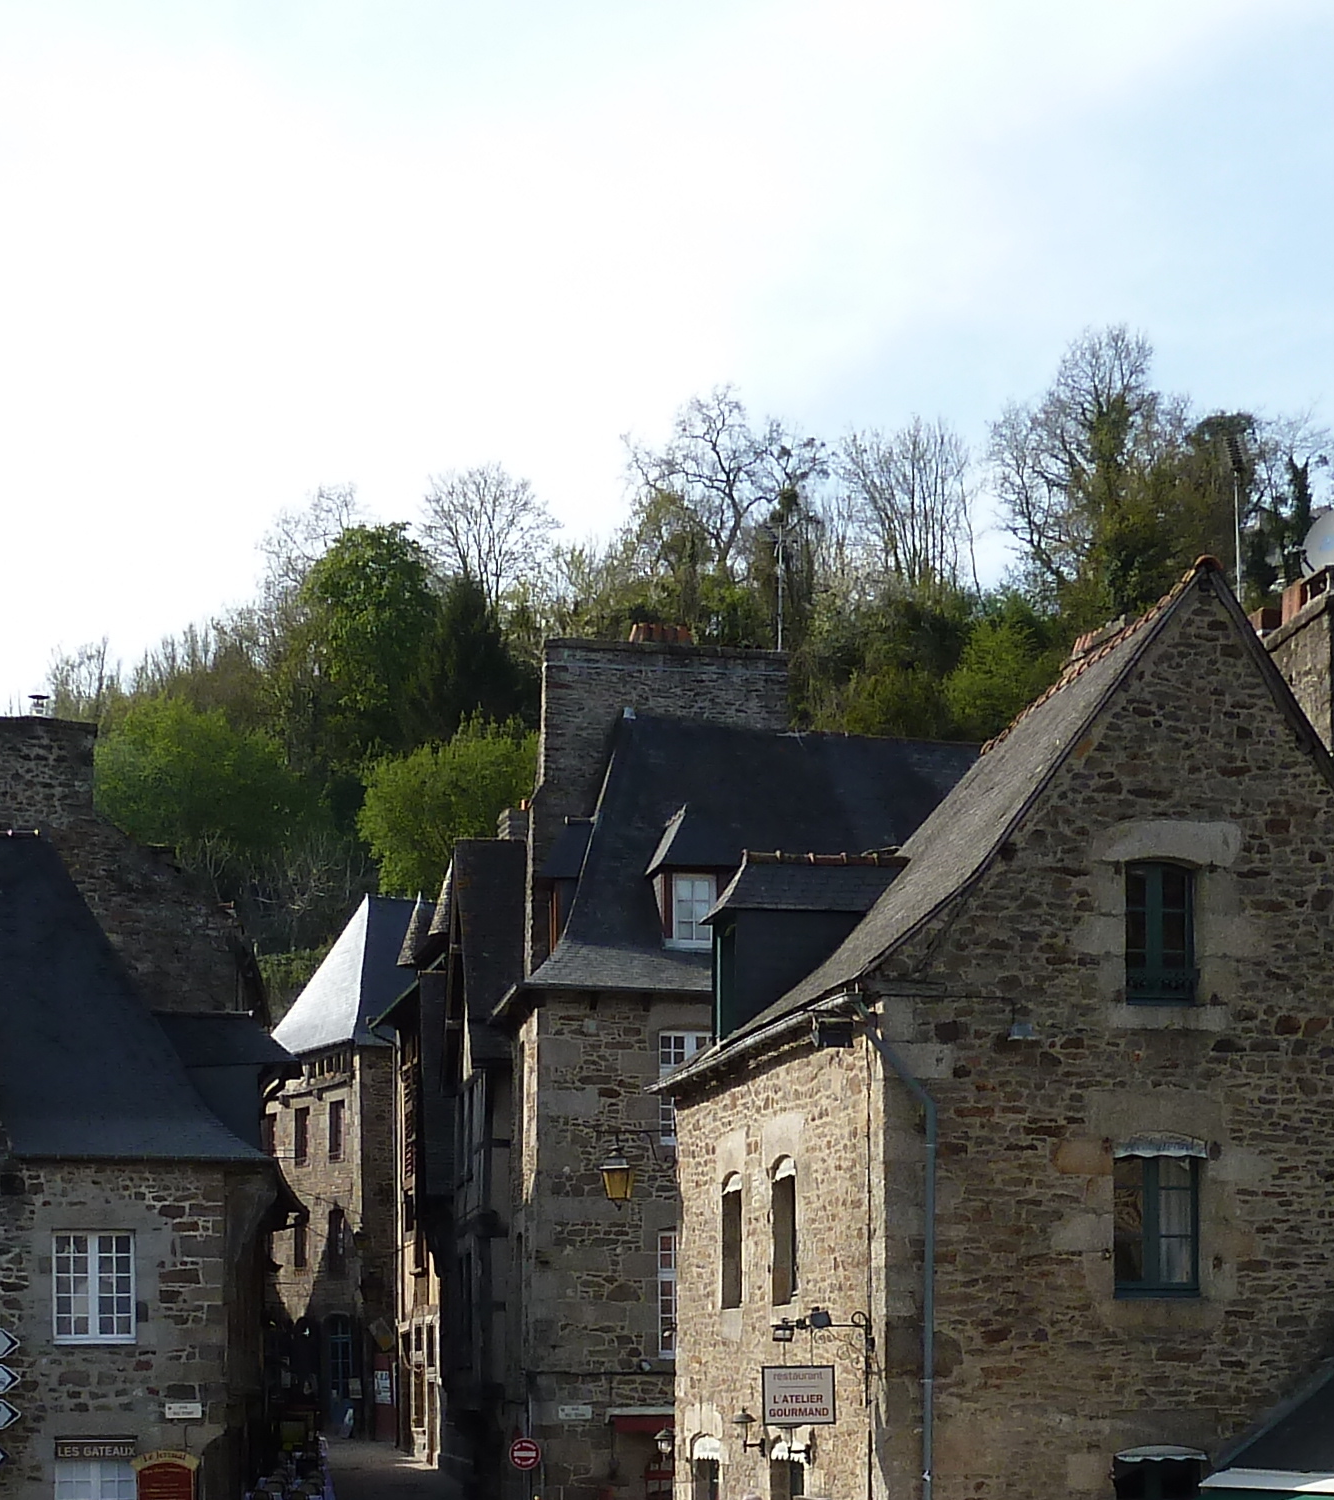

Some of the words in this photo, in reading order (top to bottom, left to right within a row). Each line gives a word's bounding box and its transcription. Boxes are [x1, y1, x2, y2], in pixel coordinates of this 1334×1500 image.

[773, 1371, 824, 1381] restaurant
[773, 1394, 824, 1404] L'ATELIER
[769, 1407, 829, 1418] GOURMAND
[58, 1446, 79, 1457] LES
[83, 1446, 136, 1457] GATEAUX
